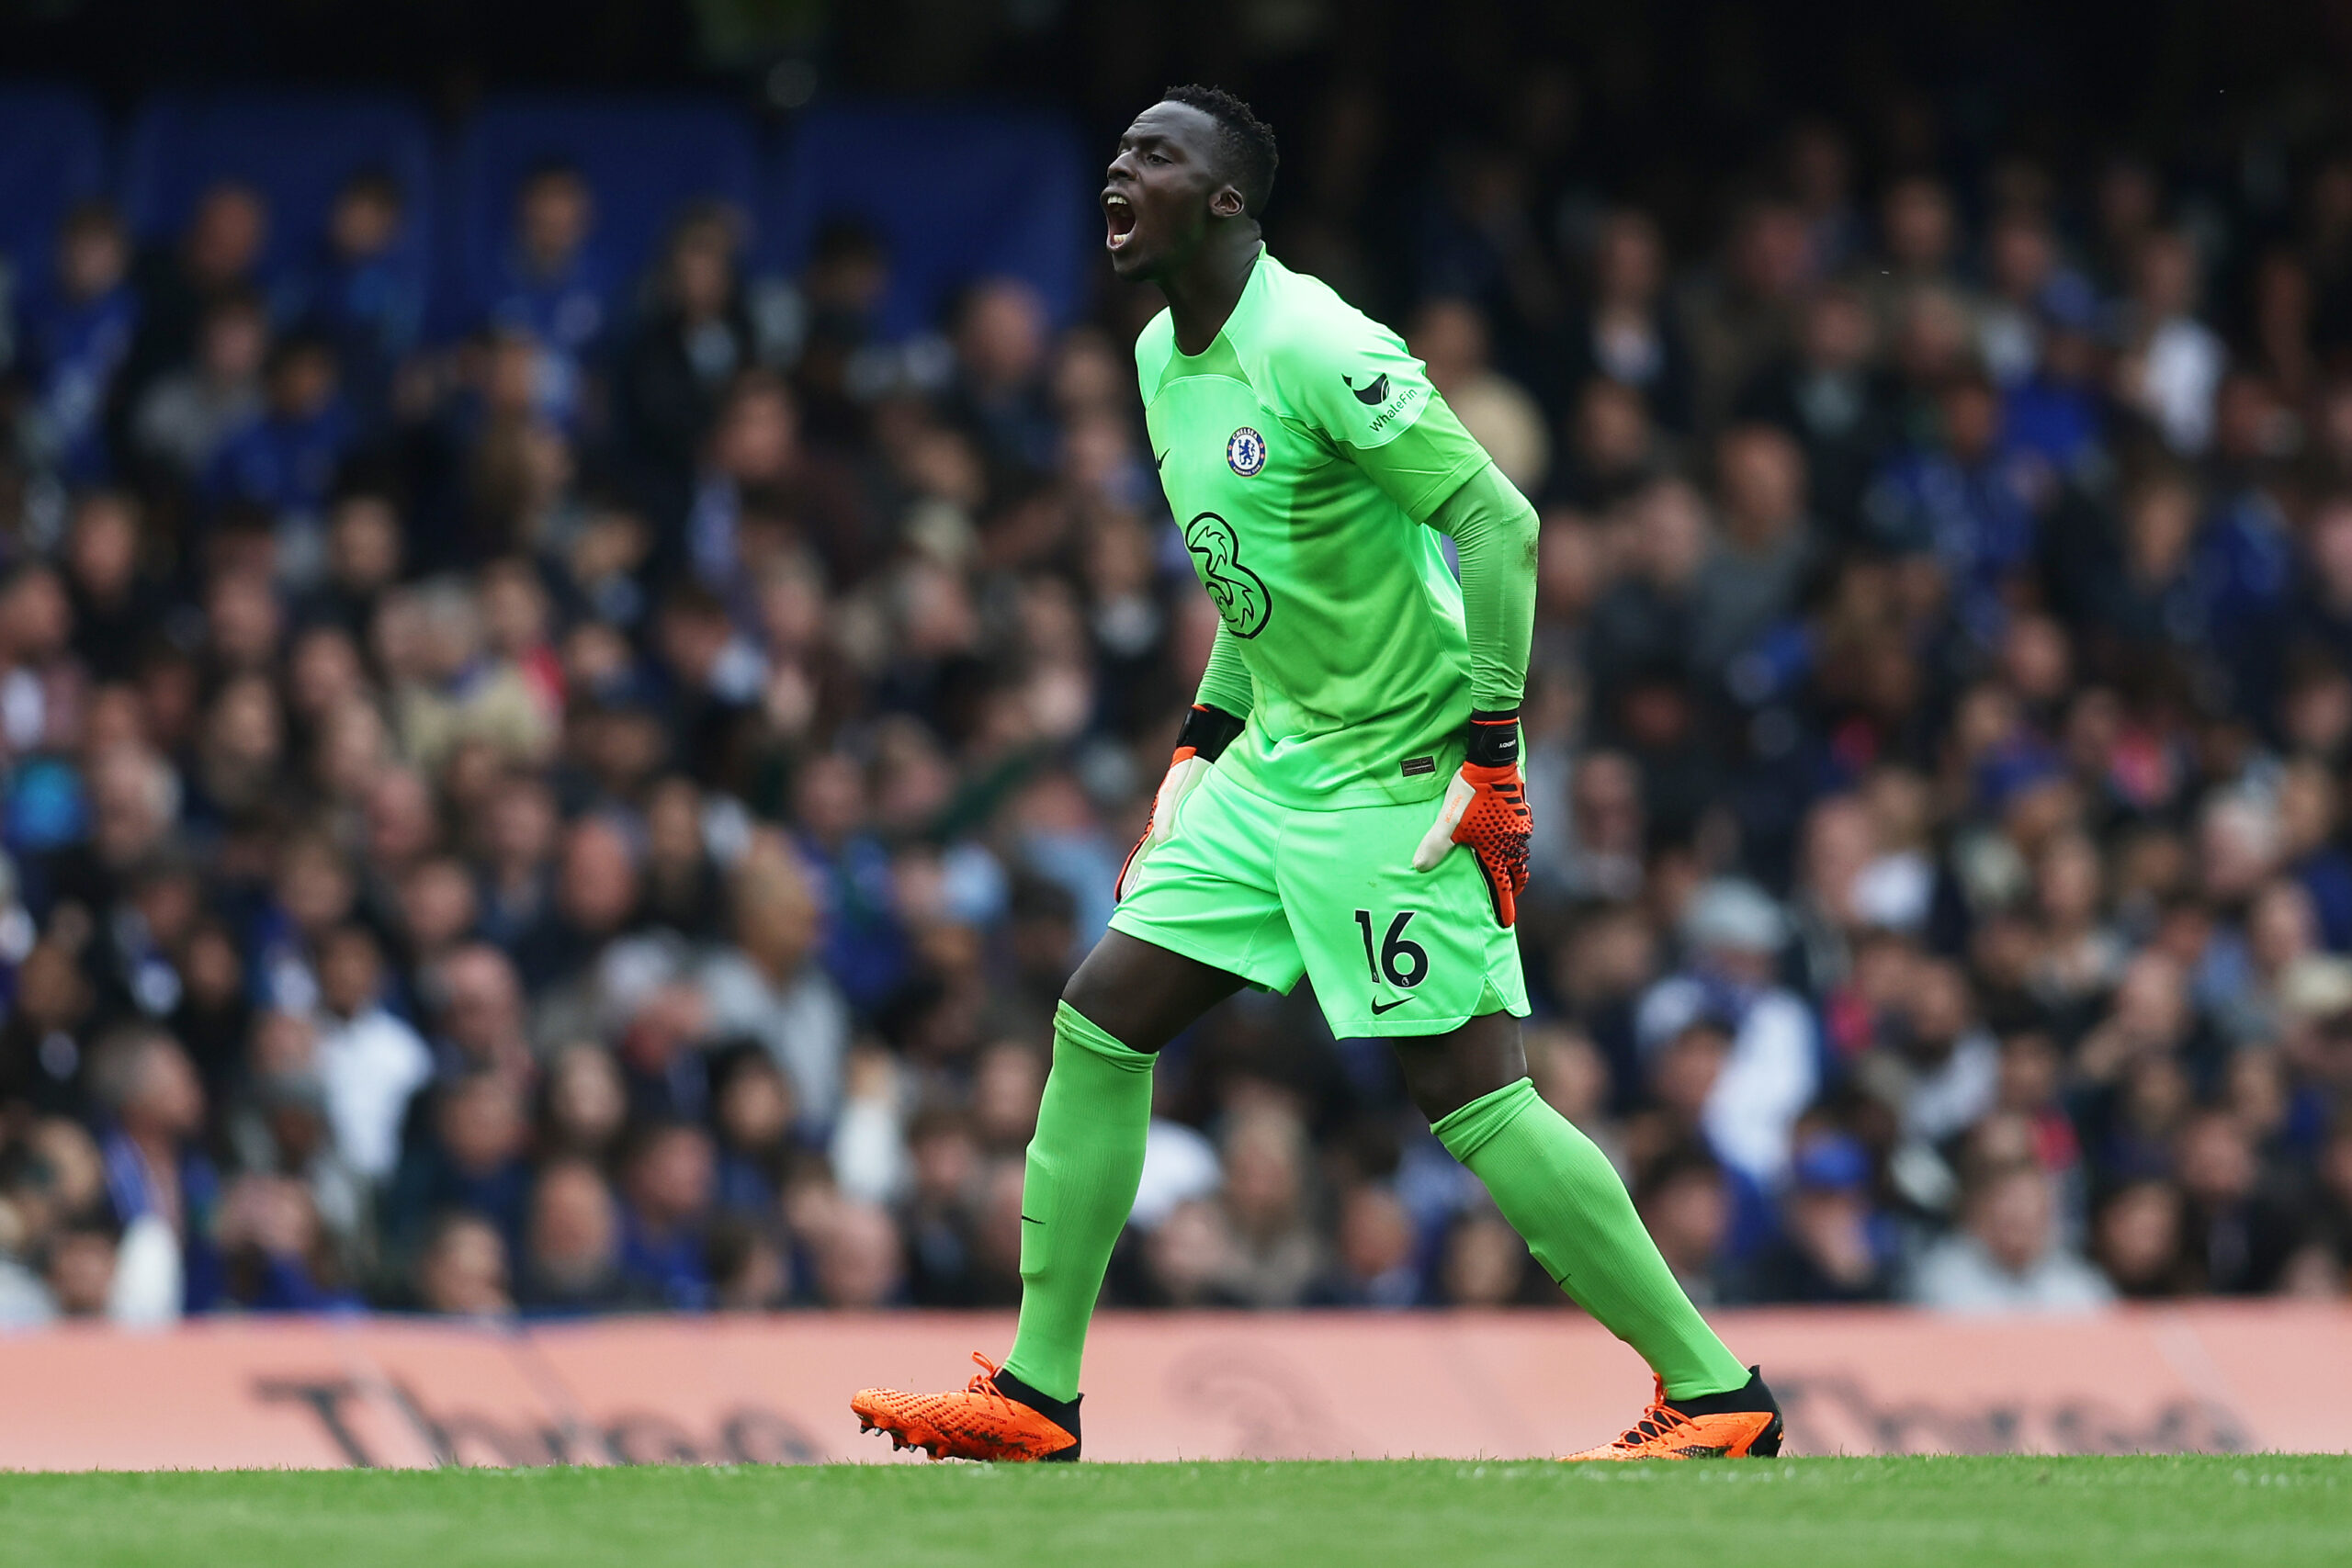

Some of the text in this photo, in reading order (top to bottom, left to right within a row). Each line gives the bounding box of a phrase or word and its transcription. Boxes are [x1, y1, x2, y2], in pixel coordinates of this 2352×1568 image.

[1368, 389, 1418, 432] WhaleFin
[1232, 428, 1258, 440] CHELSEA
[1354, 909, 1429, 988] 16
